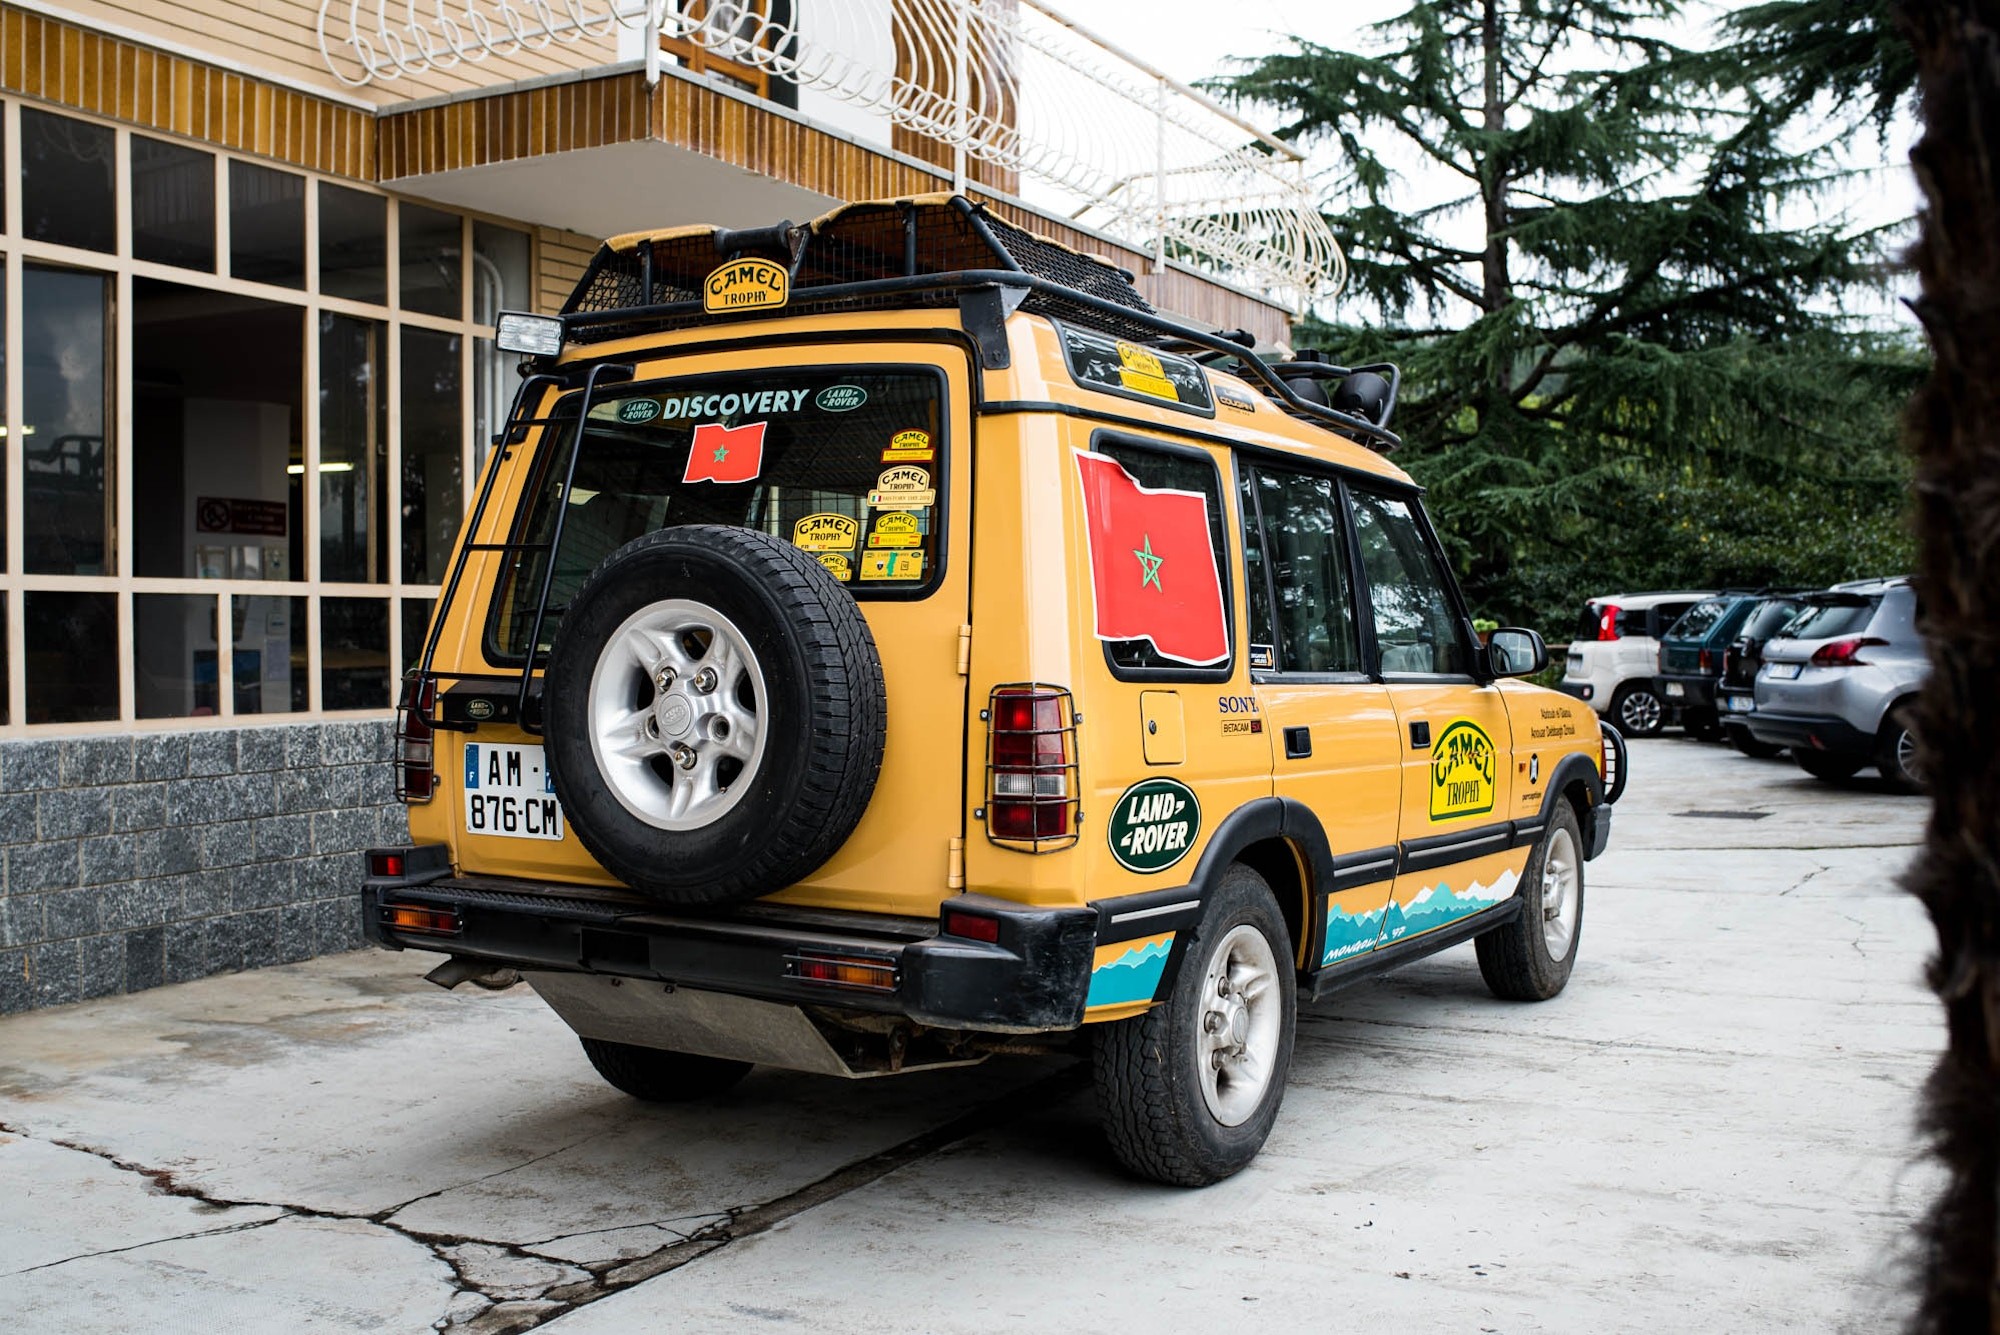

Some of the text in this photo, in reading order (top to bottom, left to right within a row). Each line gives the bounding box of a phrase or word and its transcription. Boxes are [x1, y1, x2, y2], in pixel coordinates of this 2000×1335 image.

[710, 266, 781, 295] CAMEL
[724, 290, 767, 304] TROPHY
[663, 389, 810, 420] DISCOVERY
[893, 432, 928, 444] CAMEL
[882, 471, 925, 486] CAMEL
[799, 518, 853, 536] CAMEL
[879, 516, 914, 528] CAMEL
[809, 532, 841, 541] TROPHY
[1219, 696, 1256, 713] SONY
[1223, 722, 1250, 733] BETACAM
[1434, 733, 1493, 787] CAMEL
[1446, 780, 1480, 807] TROPHY
[1323, 930, 1389, 962] MONGOLIA
